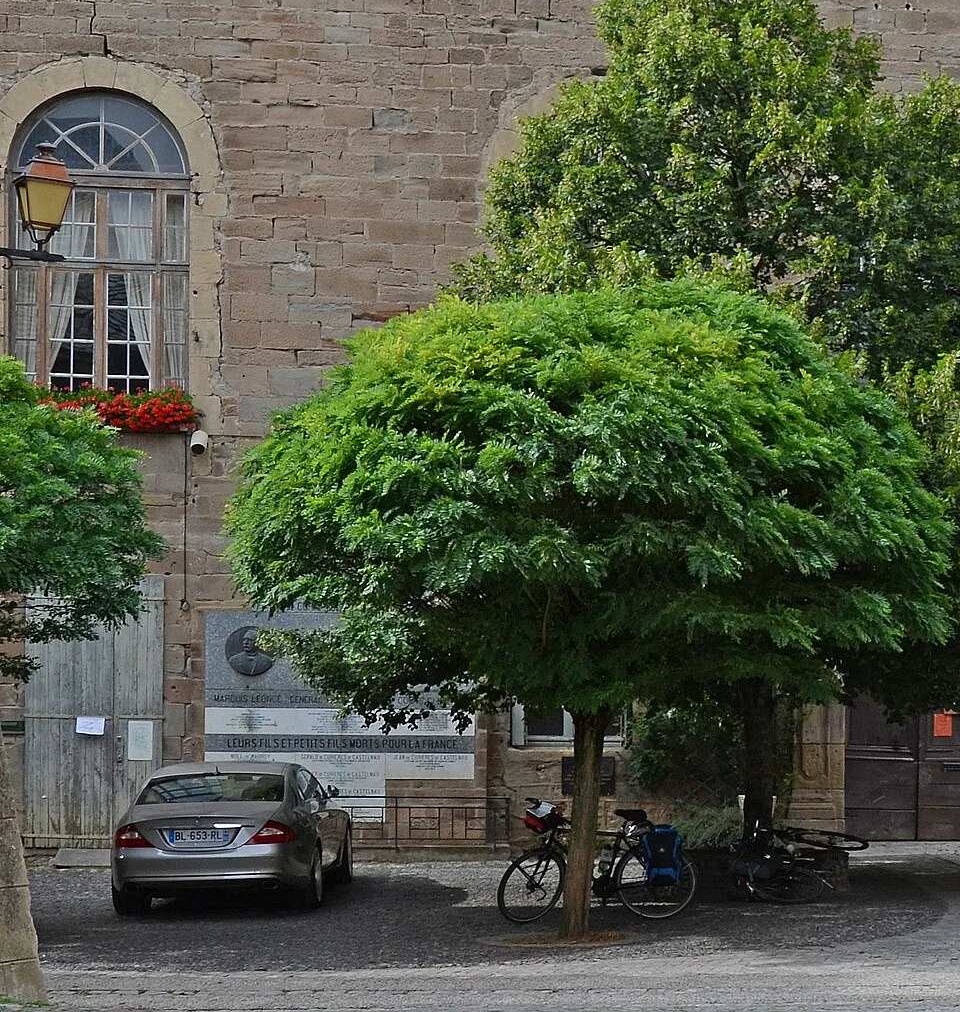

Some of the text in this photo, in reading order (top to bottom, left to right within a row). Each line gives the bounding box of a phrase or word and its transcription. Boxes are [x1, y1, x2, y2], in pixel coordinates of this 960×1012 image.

[227, 738, 457, 749] LEURS FILS ET PETITS FILS MORTS POUR LA FRANCE
